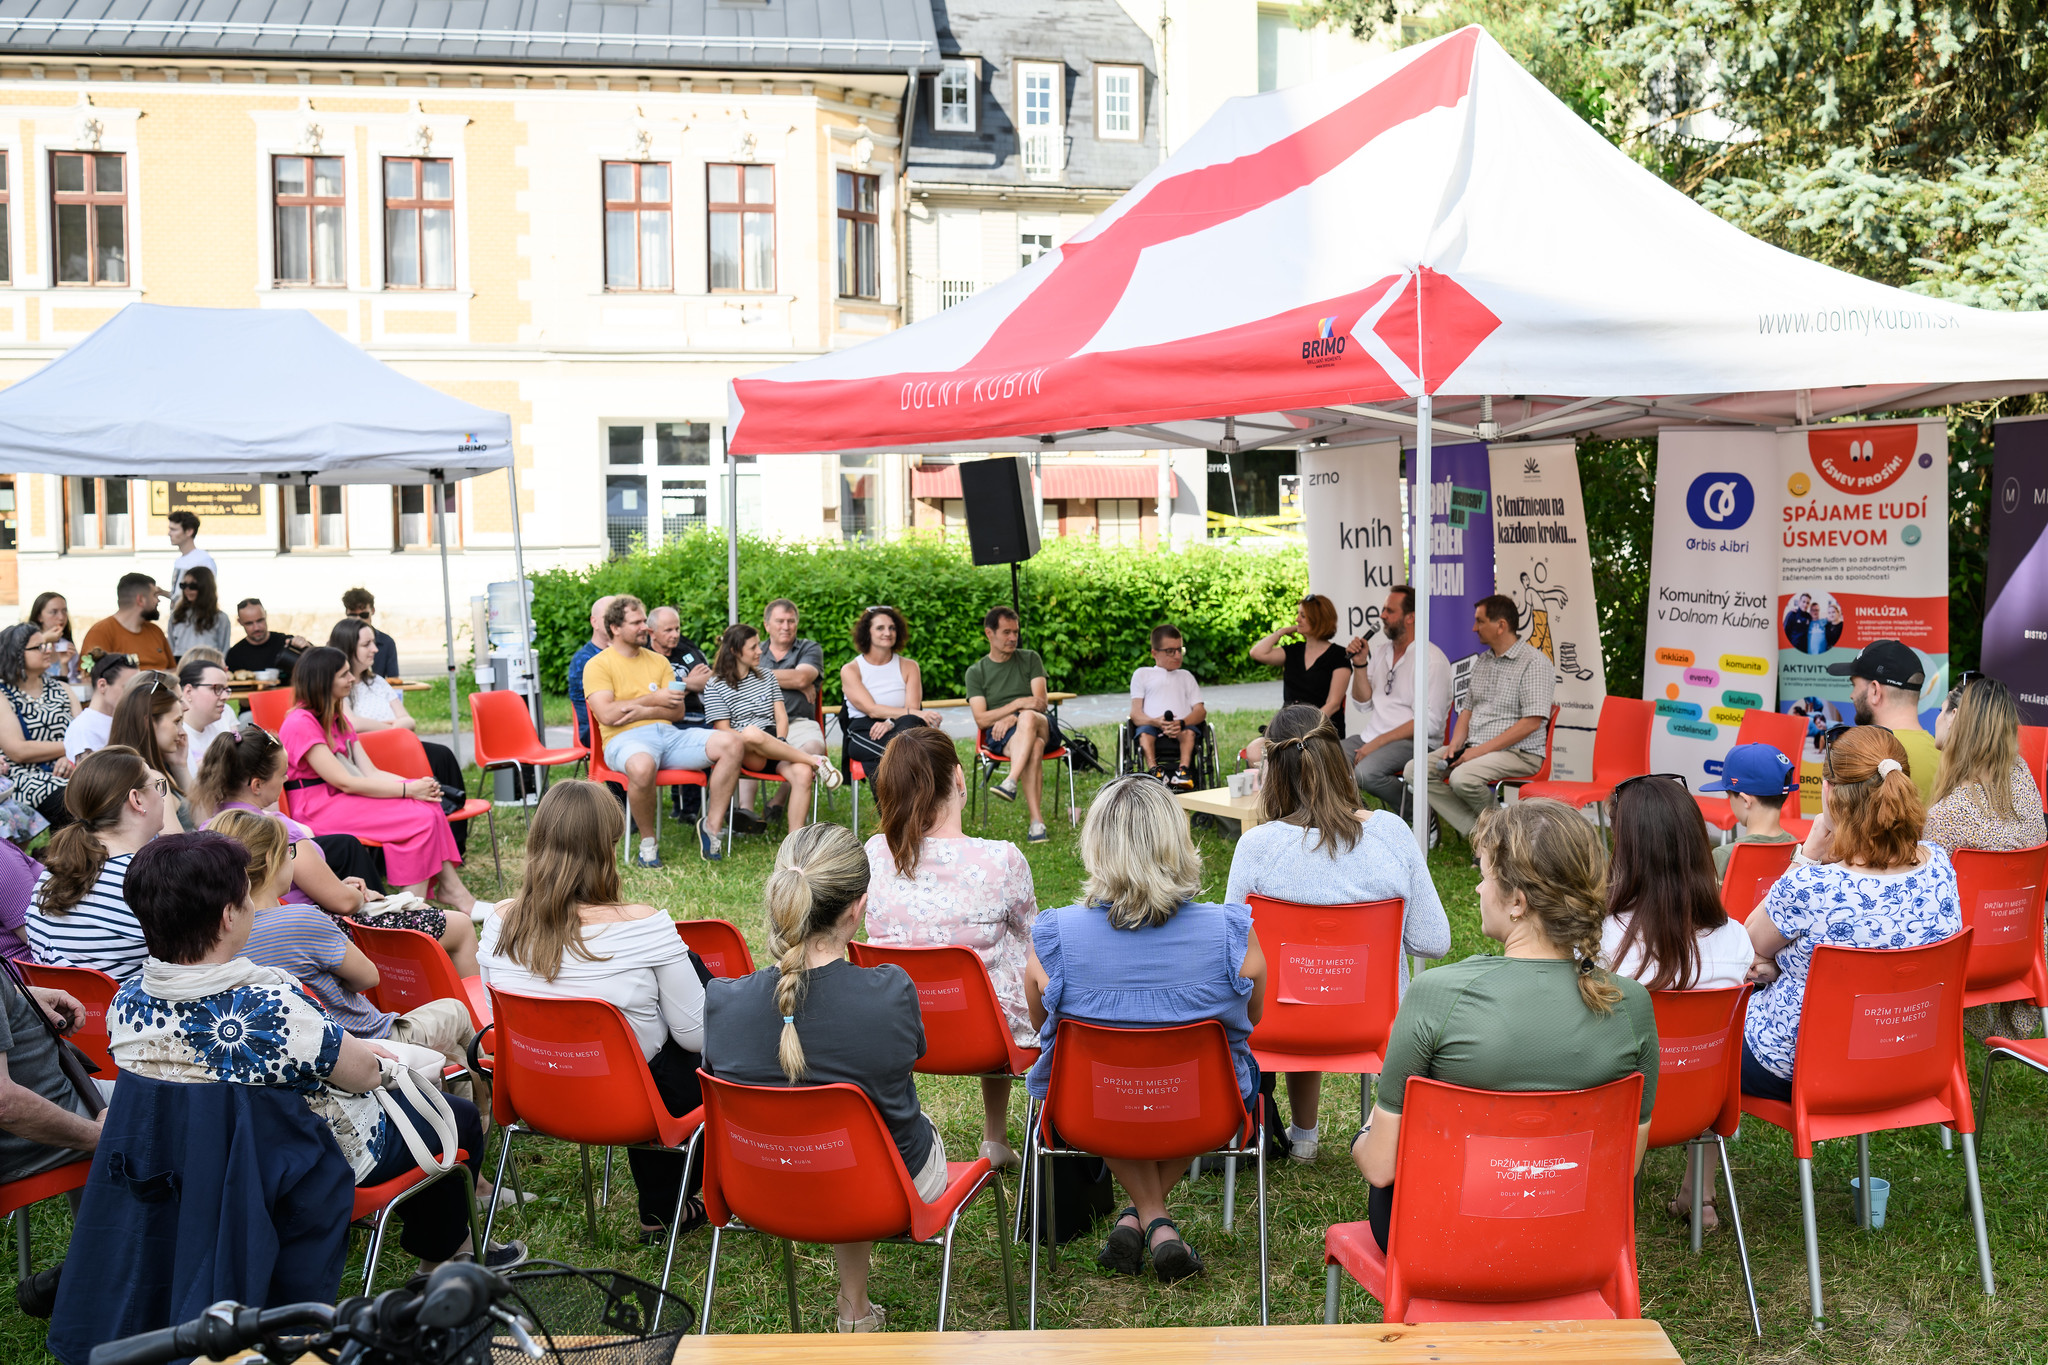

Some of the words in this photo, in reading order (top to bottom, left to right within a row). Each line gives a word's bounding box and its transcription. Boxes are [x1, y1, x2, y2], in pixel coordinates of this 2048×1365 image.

[1302, 336, 1345, 359] BRIMO
[458, 444, 487, 452] BRIMO
[1821, 458, 1855, 487] ÚSMEV
[1858, 455, 1902, 487] PROSÍM!
[1309, 472, 1339, 485] zrno
[1497, 495, 1502, 517] S
[1504, 495, 1550, 517] knižnicou
[1552, 498, 1564, 516] na
[1783, 499, 1873, 522] SPÁJAME
[1879, 495, 1928, 520] ĽUDÍ
[1340, 518, 1392, 550] kníh
[1498, 521, 1537, 543] každom
[1538, 521, 1577, 543] kroku...
[1783, 525, 1887, 547] ÚSMEVOM
[1686, 538, 1716, 551] Orbis
[1720, 541, 1749, 553] Libri
[1859, 555, 1906, 563] zdravotným
[1364, 560, 1393, 587] ku
[1659, 587, 1730, 609] Komunitný
[1734, 593, 1767, 608] život
[1855, 605, 1908, 616] INKLÚZIA
[1348, 604, 1385, 635] pe
[1658, 609, 1666, 620] v
[1669, 607, 1718, 625] Dolnom
[1722, 612, 1769, 629] Kubíne
[2024, 630, 2047, 640] BISTRO
[1661, 652, 1689, 662] inklúzia
[1726, 659, 1761, 670] komunita
[1689, 673, 1713, 684] eventy
[1729, 695, 1755, 706] kultúra
[1658, 704, 1696, 716] aktivizmus
[1673, 723, 1712, 736] vzdelanosť
[1290, 957, 1314, 966] DRŽÍM
[938, 987, 959, 995] MESTO
[1865, 1008, 1891, 1016] DRŽÍM
[1875, 1017, 1900, 1025] TVOJE
[1902, 1011, 1926, 1022] MESTO
[576, 1050, 600, 1058] MESTO
[1104, 1077, 1132, 1086] DRŽÍM
[1146, 1086, 1179, 1094] MESTO
[815, 1140, 844, 1151] MESTO
[1490, 1158, 1520, 1167] DRŽÍM
[1496, 1171, 1522, 1181] TVOJE
